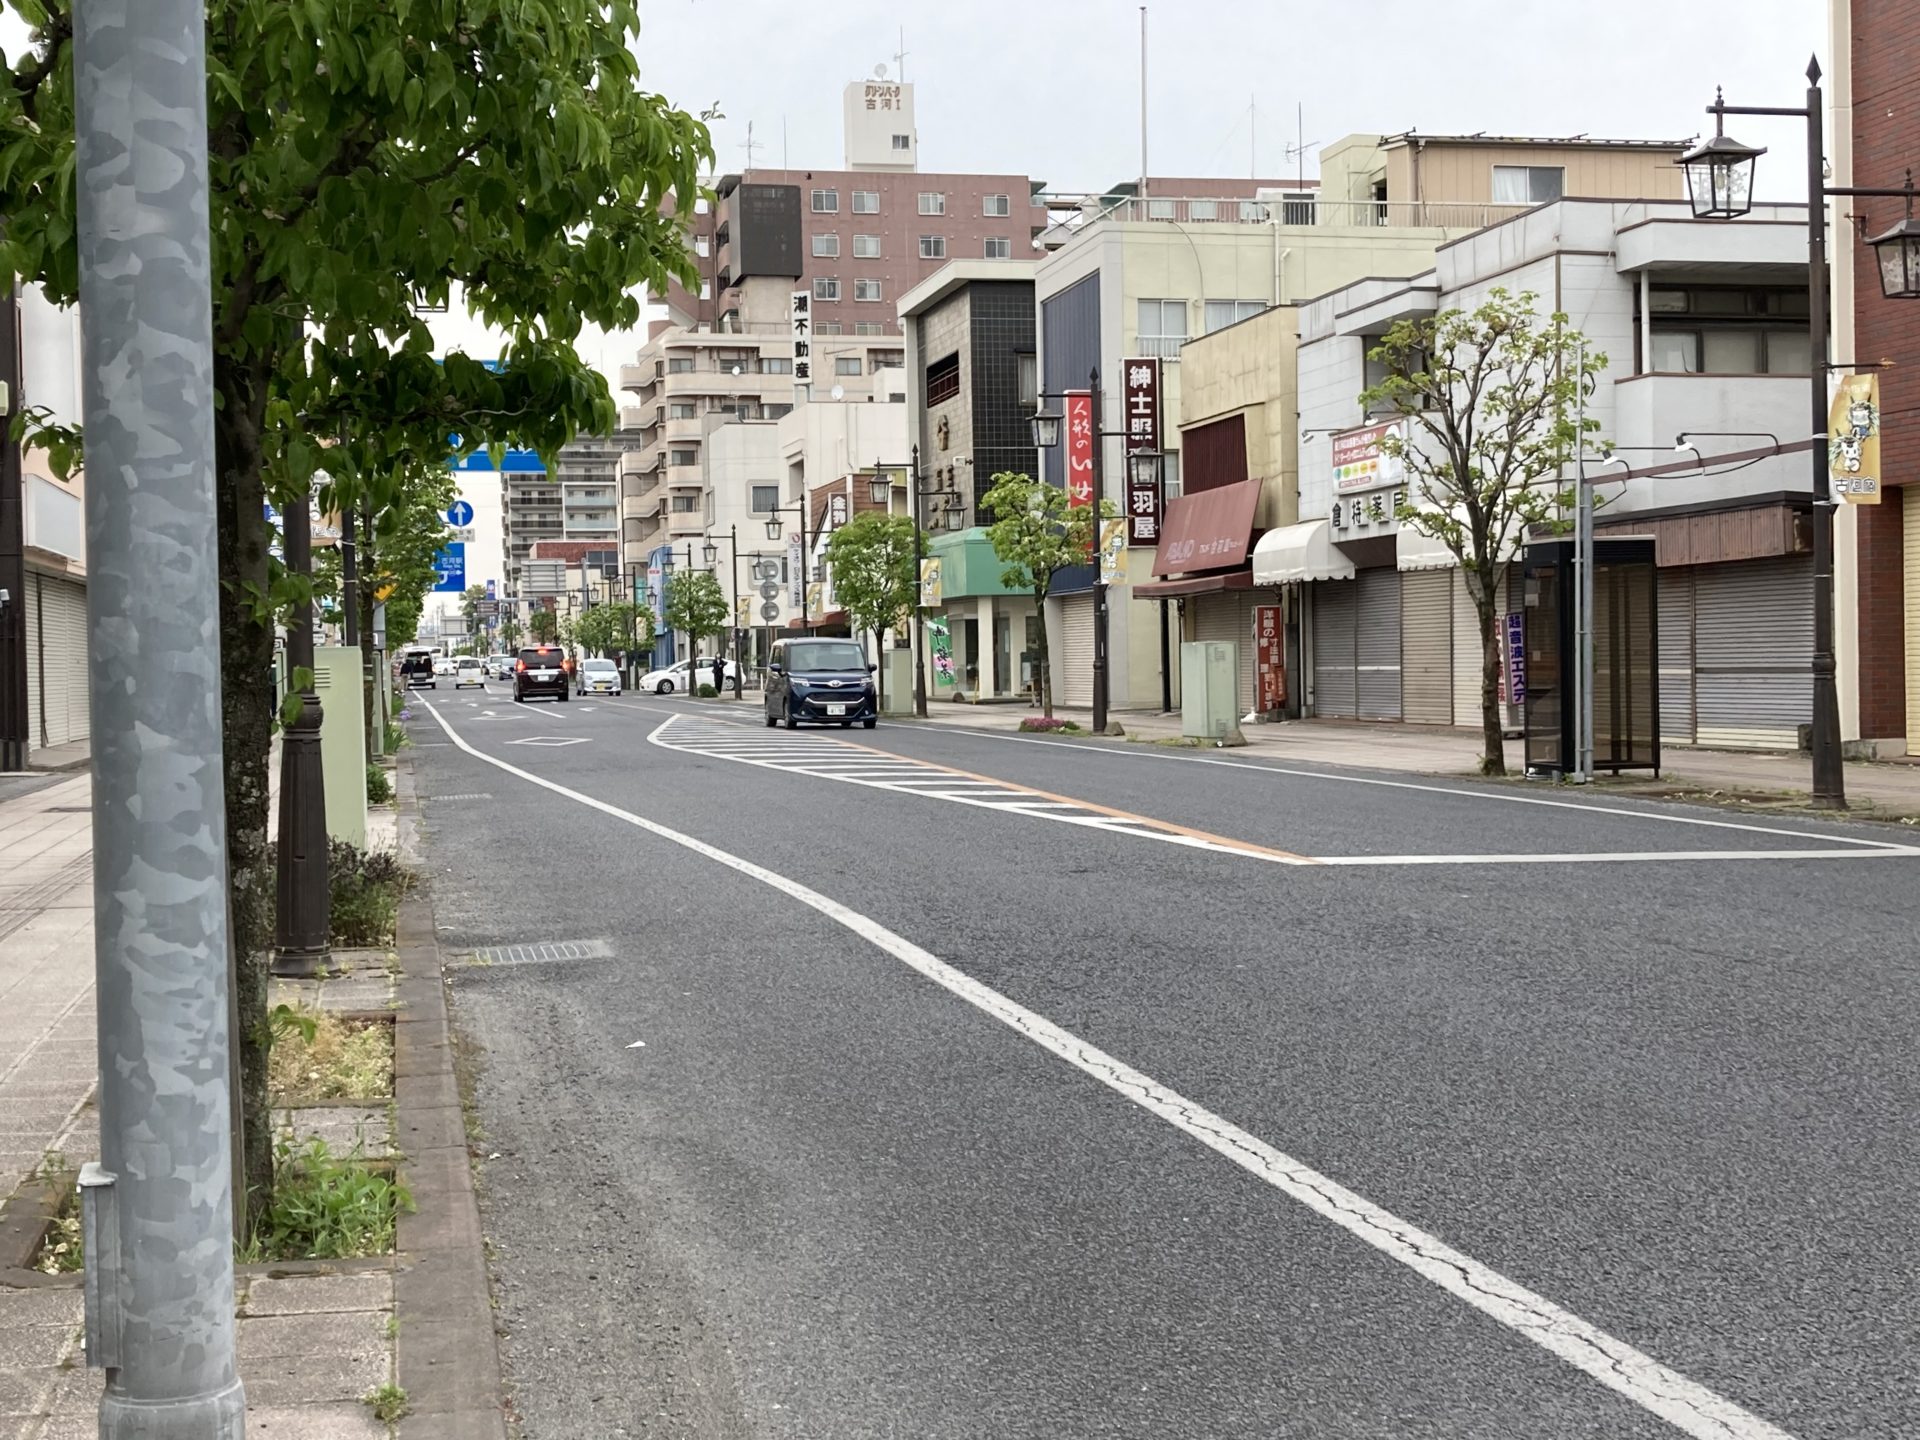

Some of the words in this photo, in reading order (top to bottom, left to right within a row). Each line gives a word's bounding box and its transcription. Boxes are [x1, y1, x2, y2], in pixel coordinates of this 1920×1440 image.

[793, 295, 810, 379] 潮不動産
[1508, 615, 1524, 702] 超音波エステ
